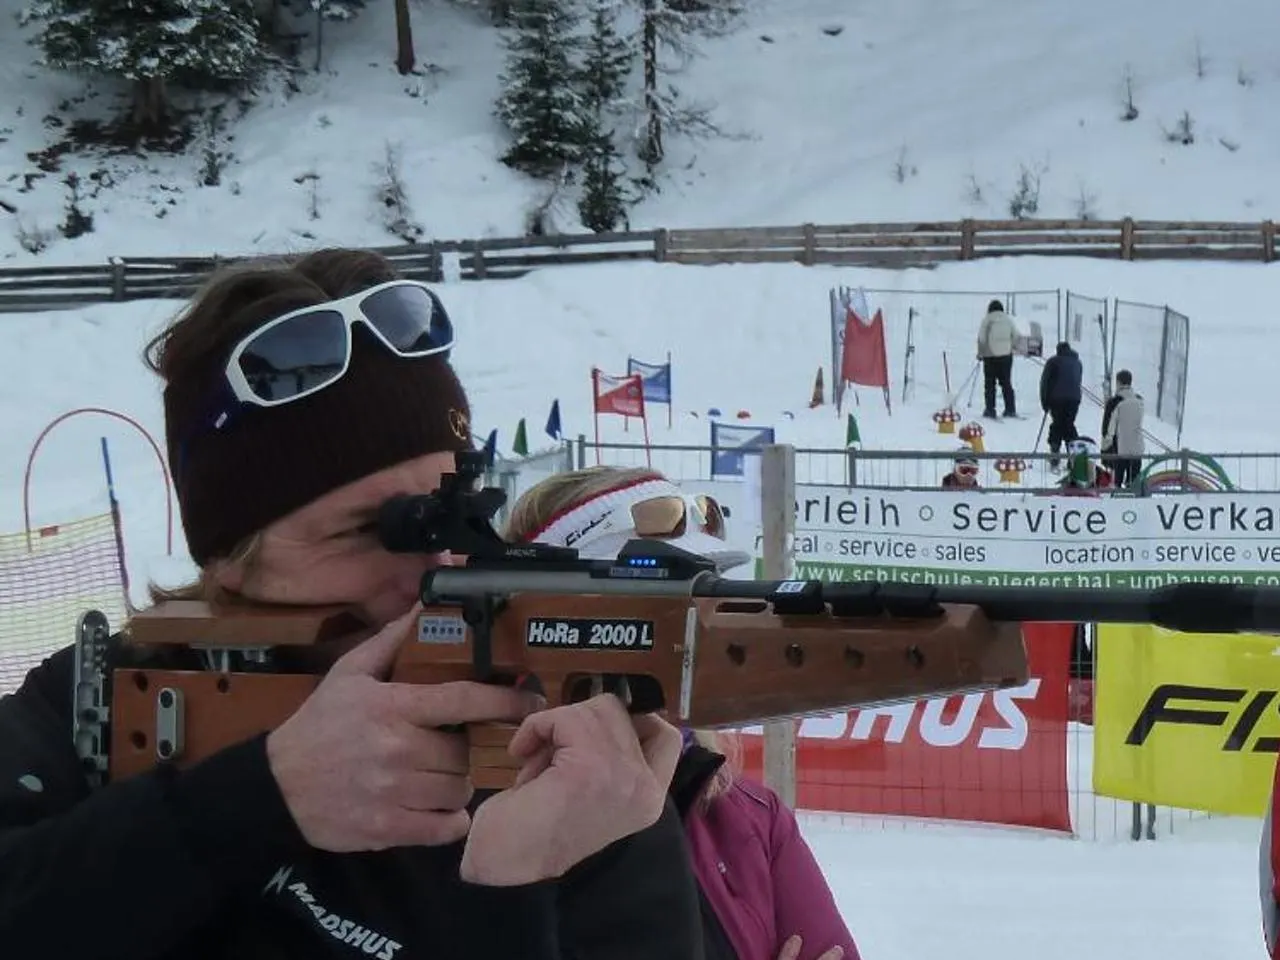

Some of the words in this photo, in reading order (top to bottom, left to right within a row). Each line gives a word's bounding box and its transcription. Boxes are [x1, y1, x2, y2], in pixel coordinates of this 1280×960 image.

[953, 502, 1107, 534] Service
[839, 539, 916, 558] service
[935, 542, 986, 562] sales
[1045, 544, 1134, 564] location
[1155, 543, 1236, 562] service
[528, 622, 579, 645] HoRa
[588, 624, 636, 646] 2000
[641, 624, 654, 646] L
